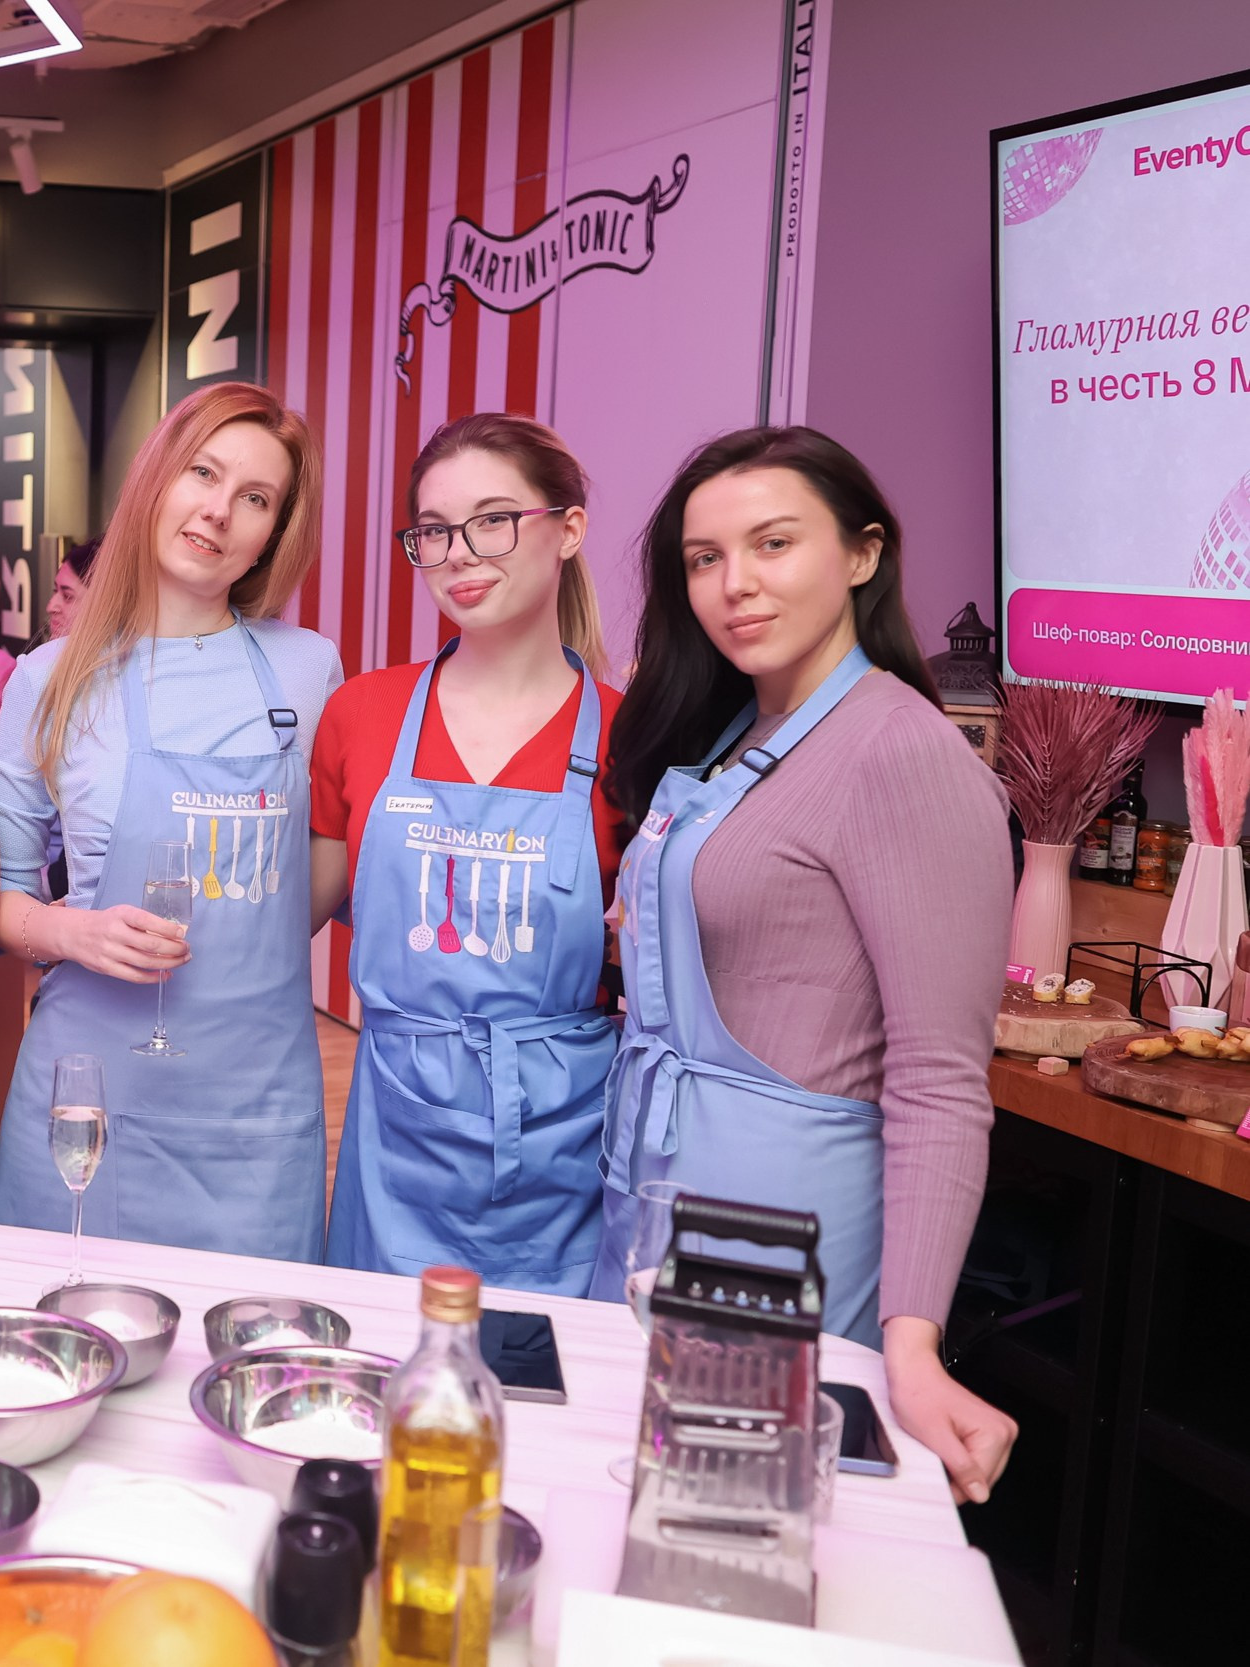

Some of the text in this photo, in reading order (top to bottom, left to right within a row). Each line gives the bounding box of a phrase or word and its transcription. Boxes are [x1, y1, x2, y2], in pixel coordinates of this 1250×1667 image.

[787, 146, 802, 258] PRODOTTO
[795, 113, 803, 133] IN
[459, 235, 547, 294] MARTINI
[565, 209, 634, 260] TONIC
[1013, 309, 1201, 356] Гламурная
[1051, 379, 1069, 404] в
[1078, 371, 1182, 401] честь
[1193, 358, 1216, 396] 8
[1032, 622, 1250, 656] Шеф-повар: Солодовни
